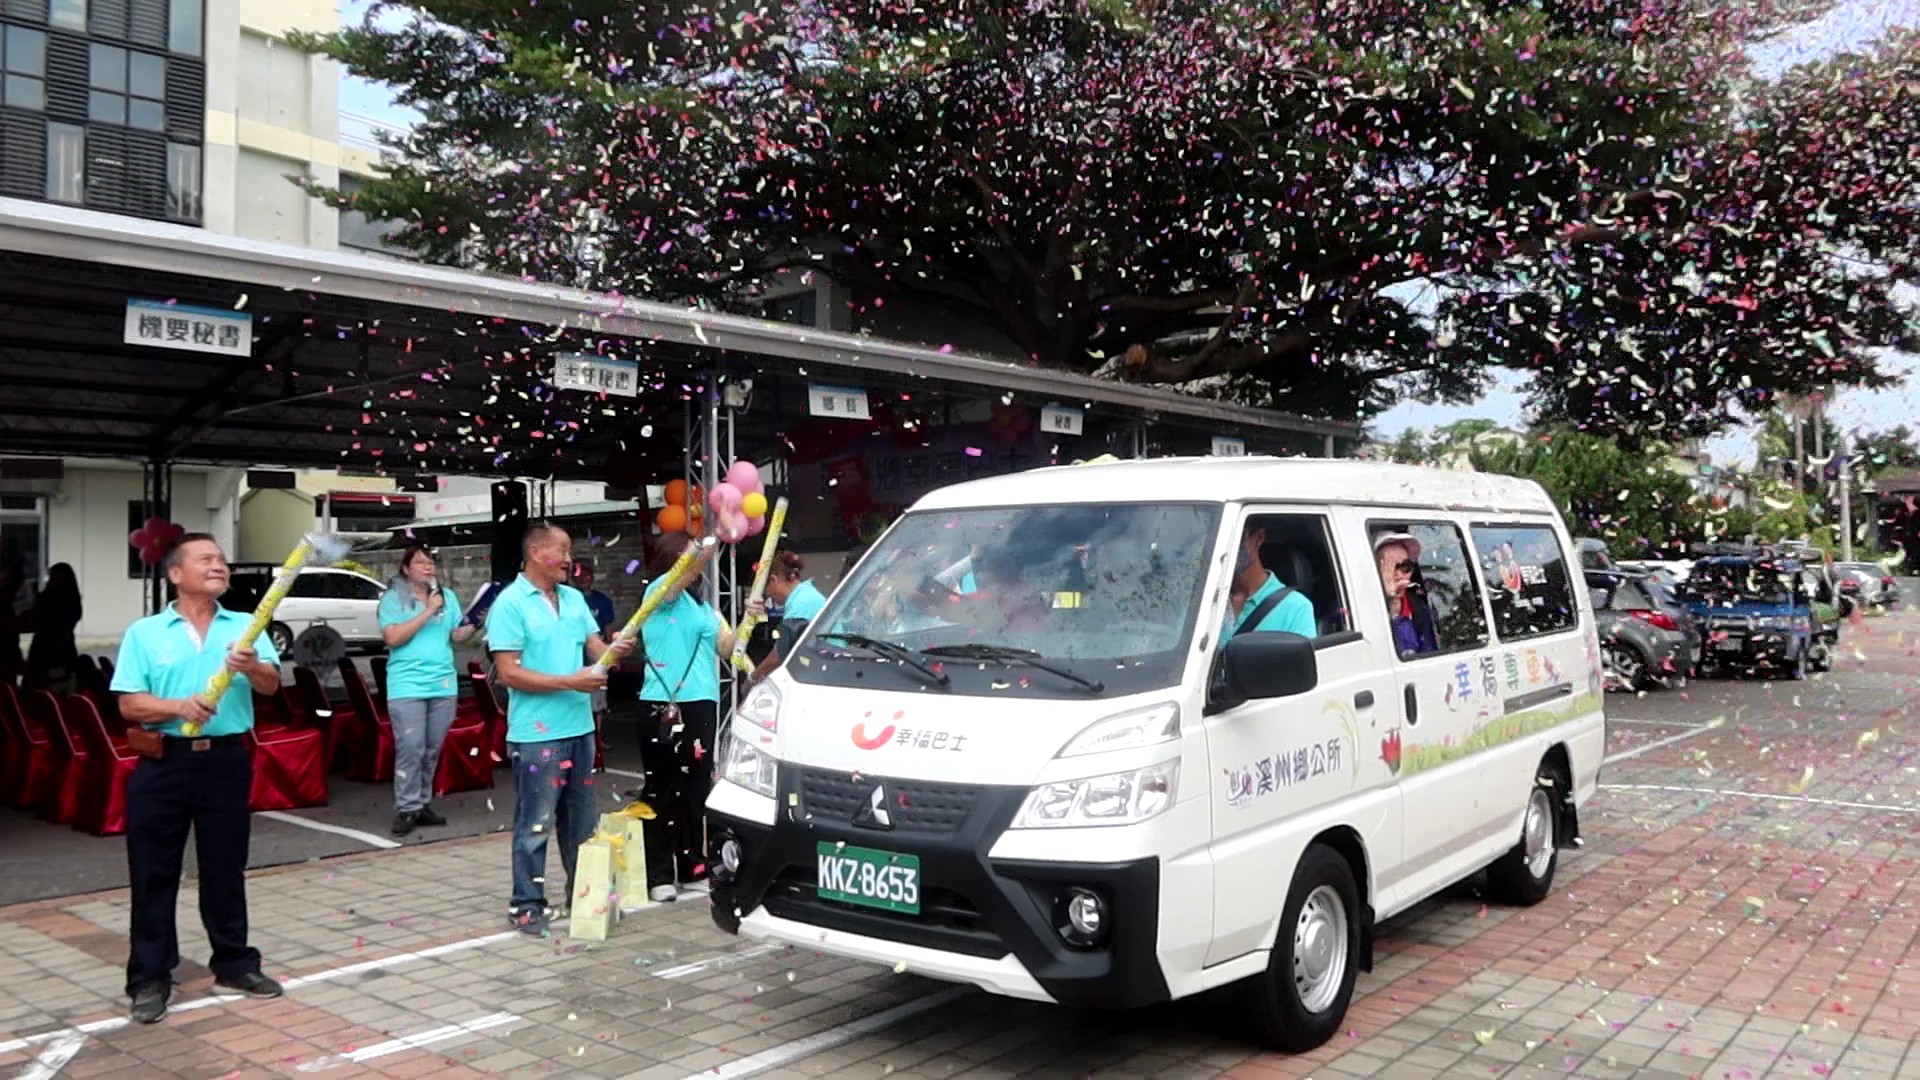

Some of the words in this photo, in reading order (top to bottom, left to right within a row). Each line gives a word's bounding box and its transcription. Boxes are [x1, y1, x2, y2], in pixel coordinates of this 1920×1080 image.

[895, 728, 968, 752] 幸福巴士
[1255, 738, 1341, 796] 溪州鄉公所
[817, 854, 919, 905] KKZ-8653
